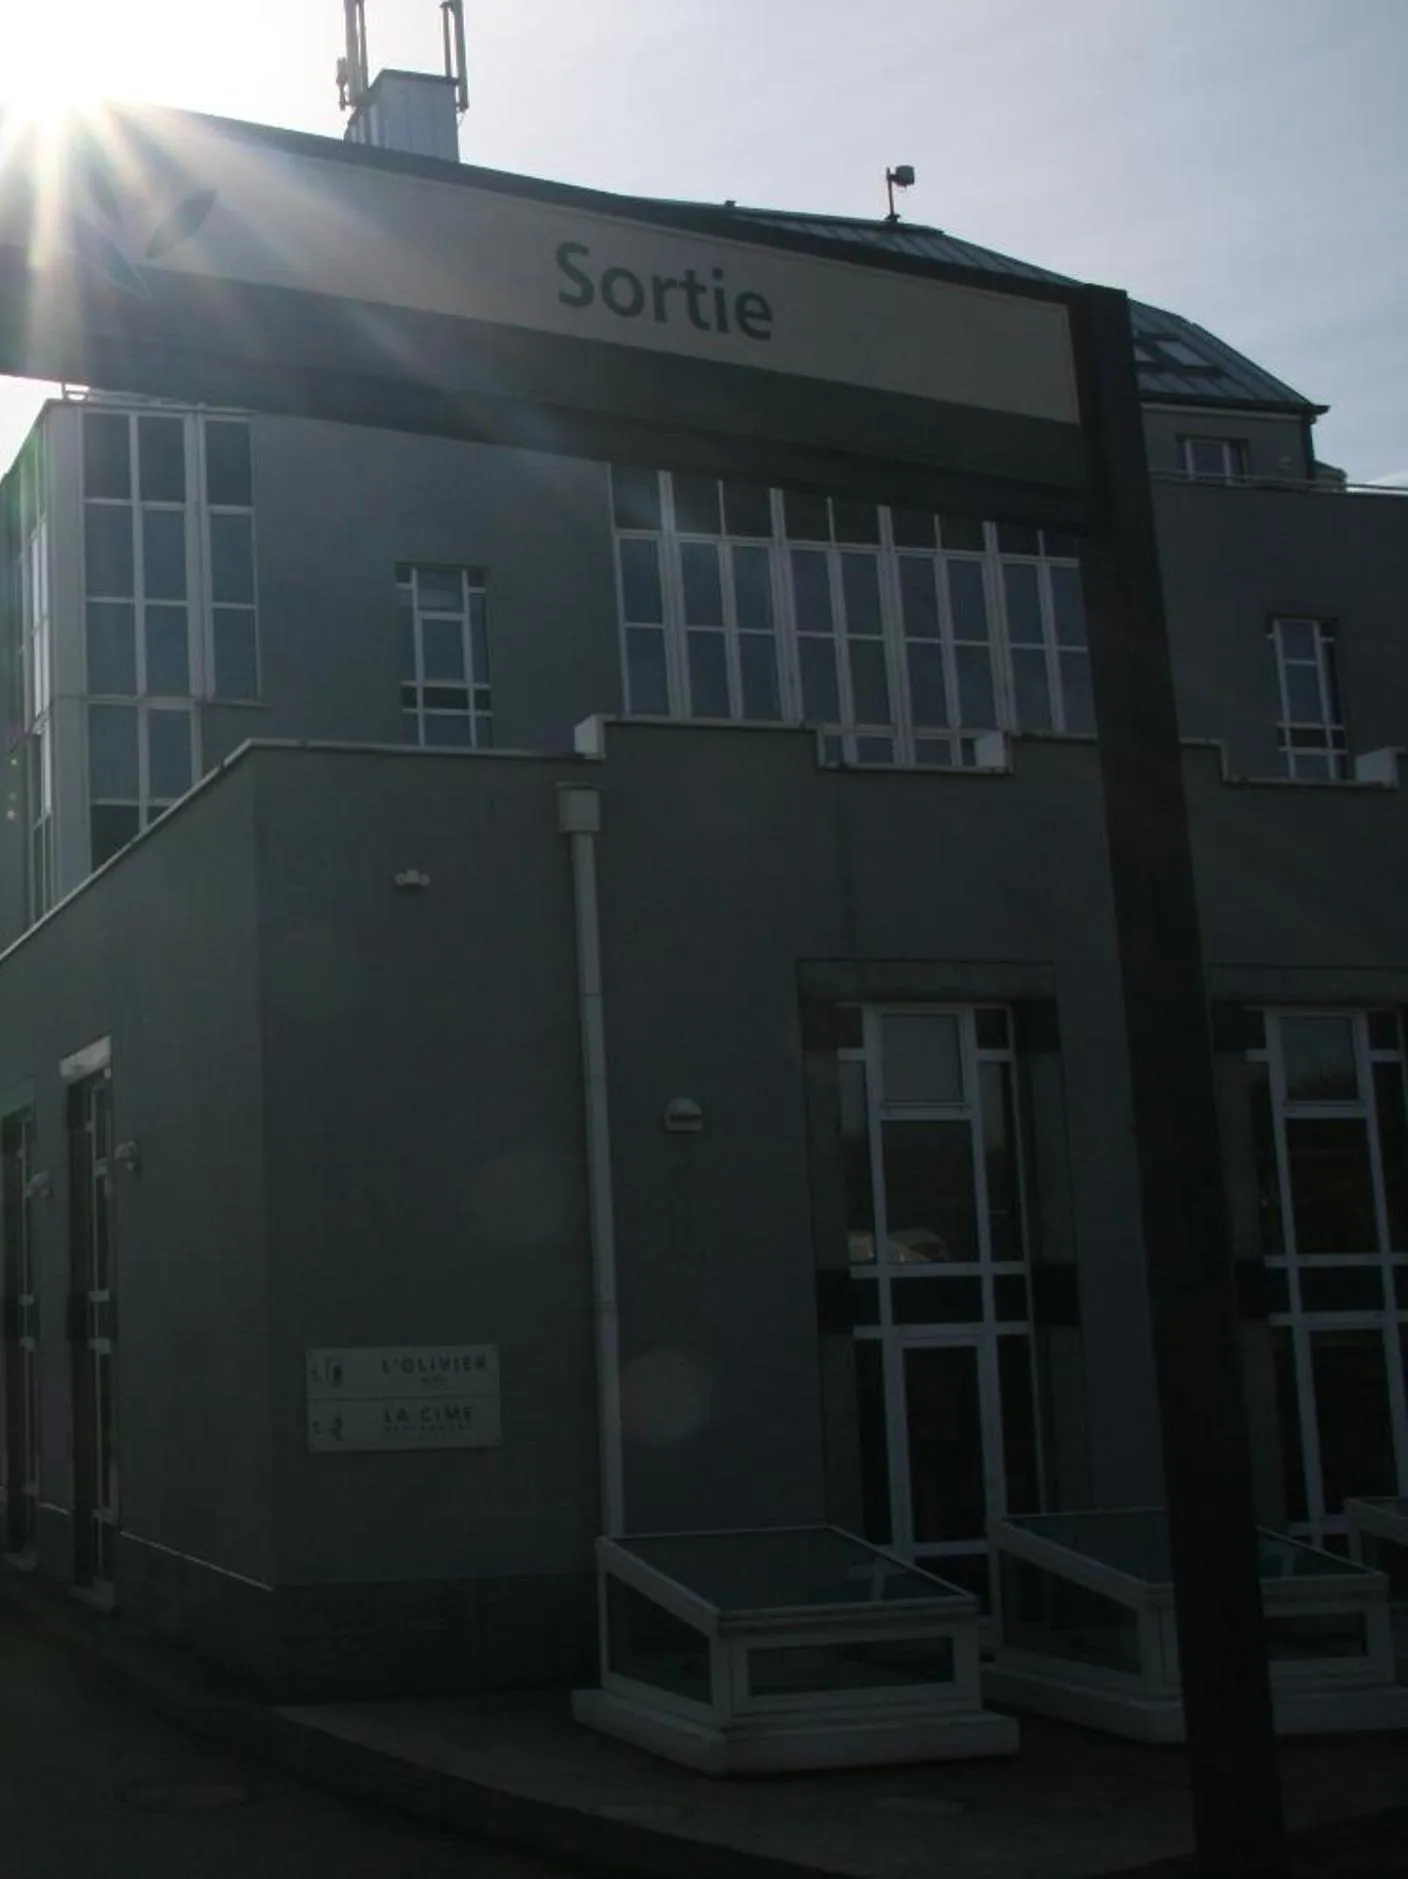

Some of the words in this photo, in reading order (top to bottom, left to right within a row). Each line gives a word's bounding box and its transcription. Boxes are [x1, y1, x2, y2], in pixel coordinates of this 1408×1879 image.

[555, 241, 773, 342] Sortie
[380, 1355, 486, 1374] L'OLIVIER
[382, 1407, 409, 1423] LA
[420, 1405, 472, 1422] CIME
